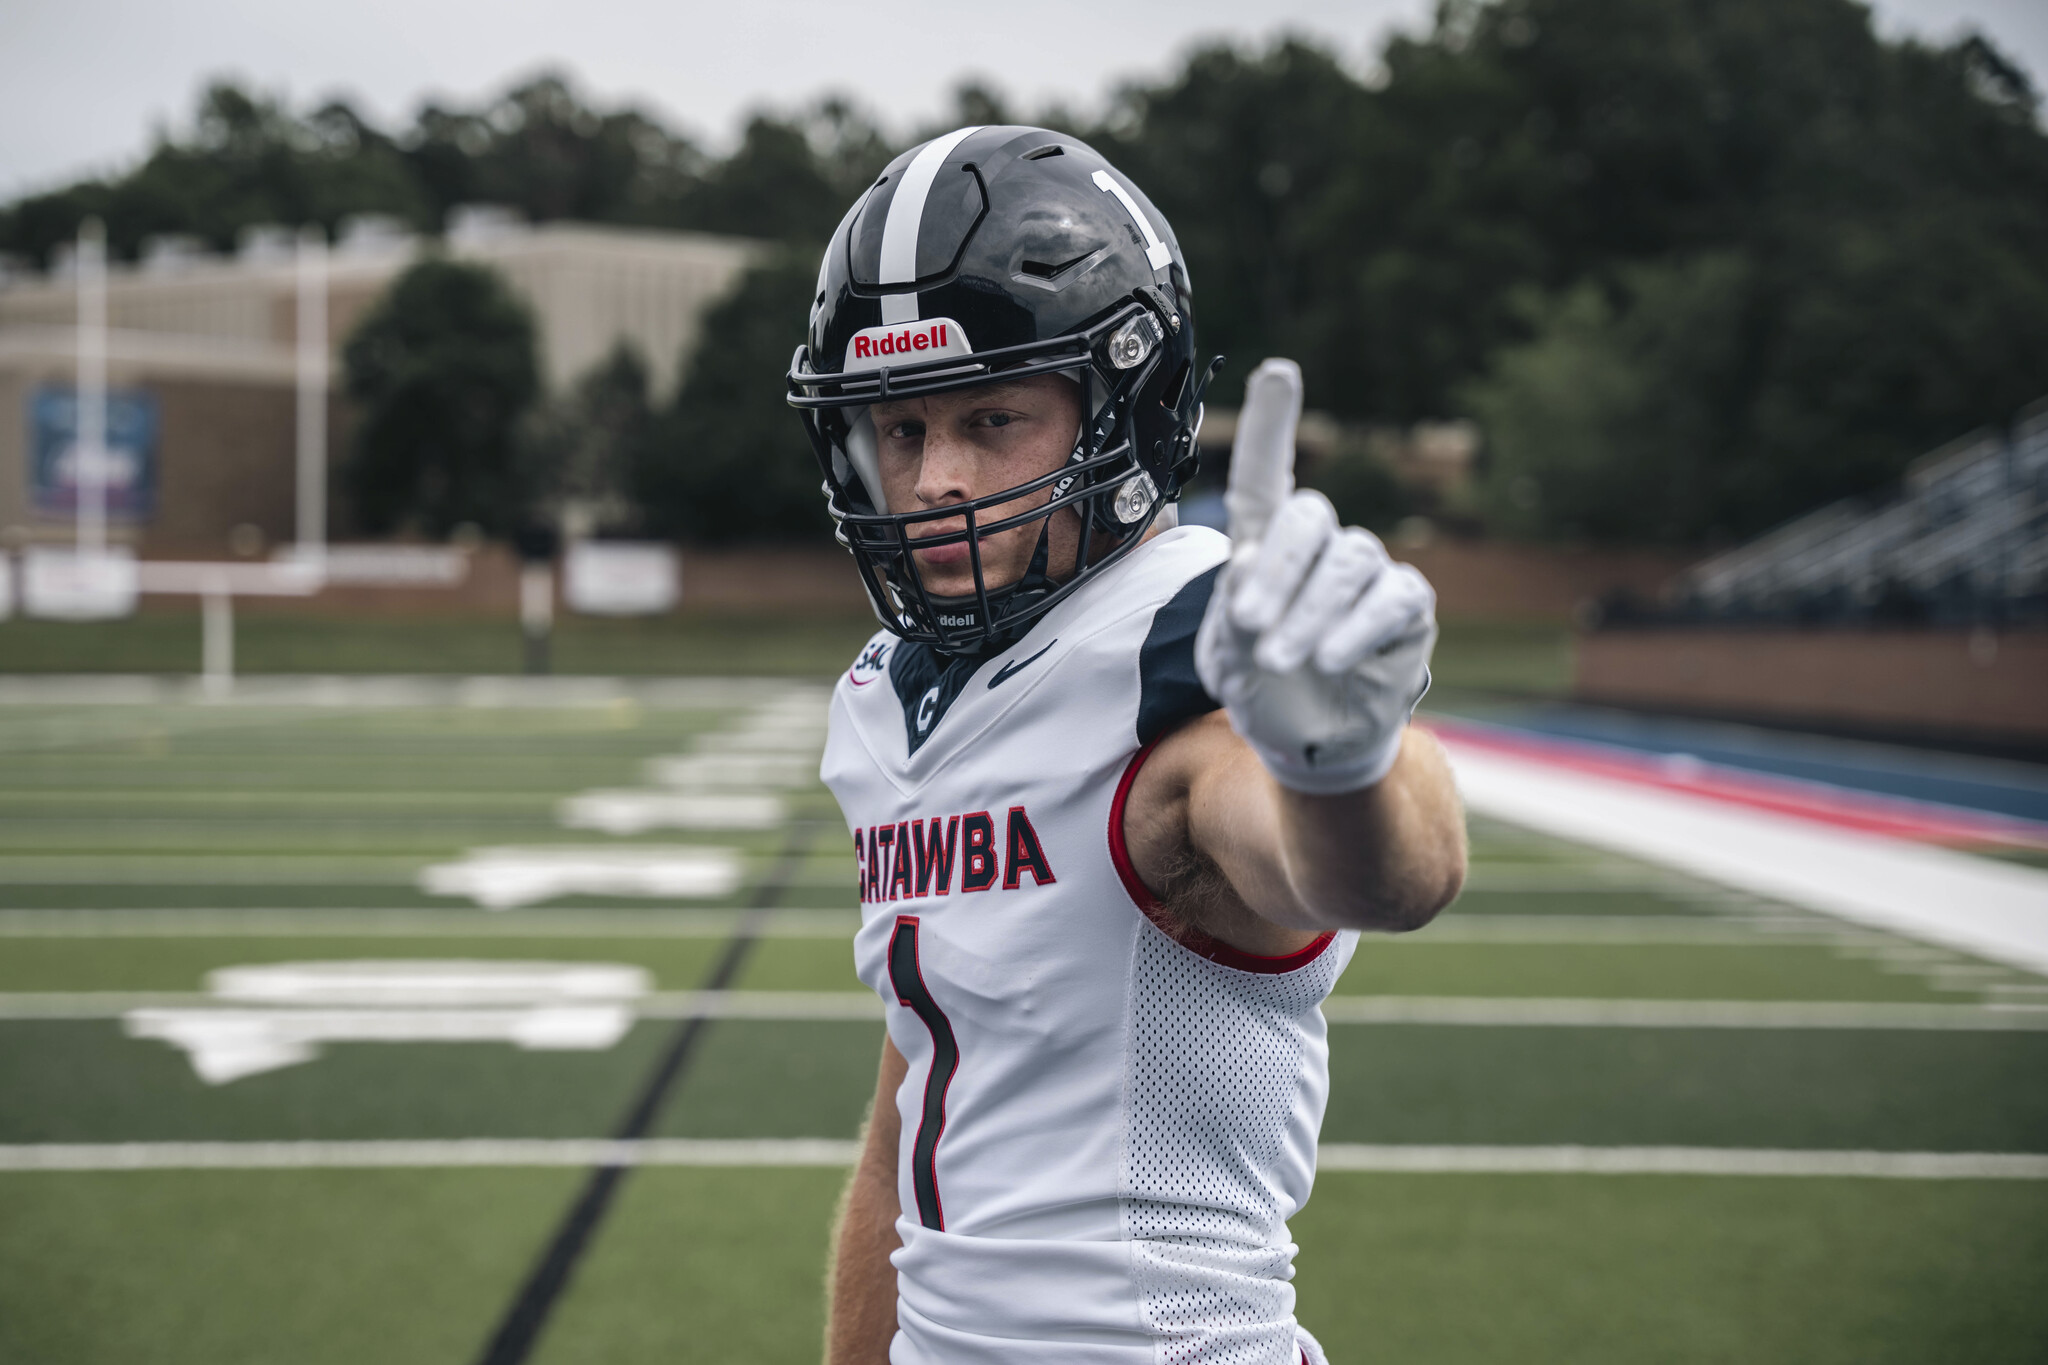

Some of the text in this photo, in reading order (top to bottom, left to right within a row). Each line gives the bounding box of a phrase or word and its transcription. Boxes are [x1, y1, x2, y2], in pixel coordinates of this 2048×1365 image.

[1091, 170, 1172, 271] 1
[855, 324, 947, 358] Riddell
[935, 613, 975, 627] ddell
[916, 686, 940, 733] C
[855, 806, 1057, 903] CATAWBA
[888, 915, 959, 1233] 1
